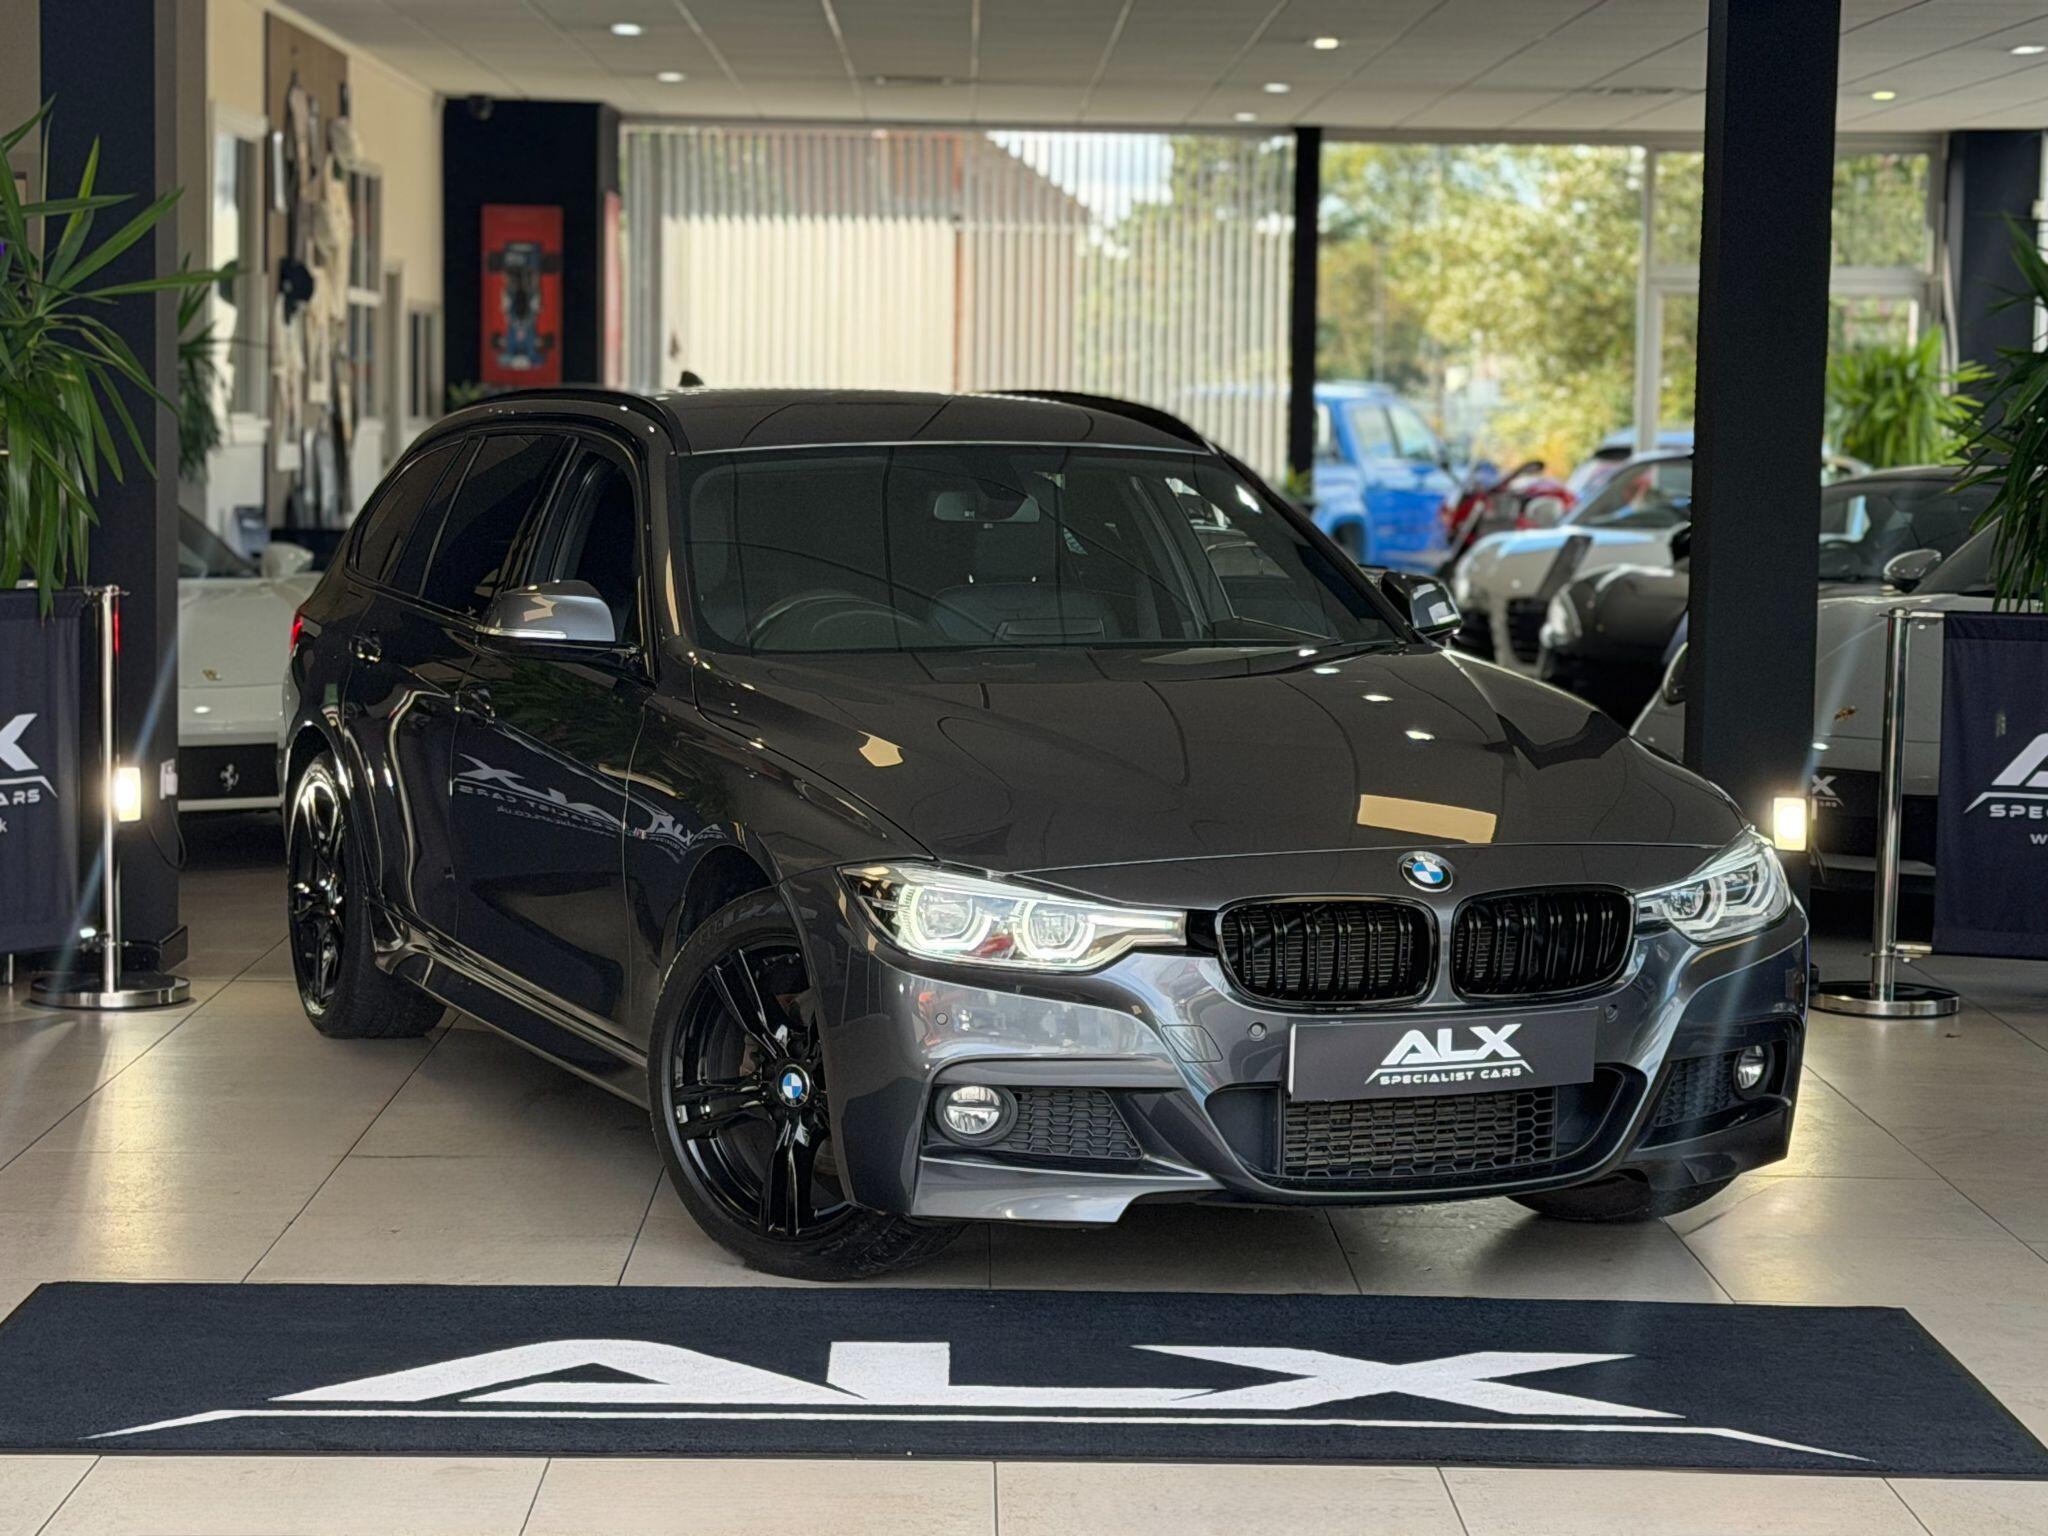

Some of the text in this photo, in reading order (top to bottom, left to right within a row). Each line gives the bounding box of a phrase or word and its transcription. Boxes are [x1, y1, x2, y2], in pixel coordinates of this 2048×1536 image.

[1989, 804, 2048, 819] SPE
[1381, 1023, 1522, 1066] ALX
[1379, 1067, 1522, 1086] SPECIALIST CARS
[270, 1338, 1685, 1419] ALX
